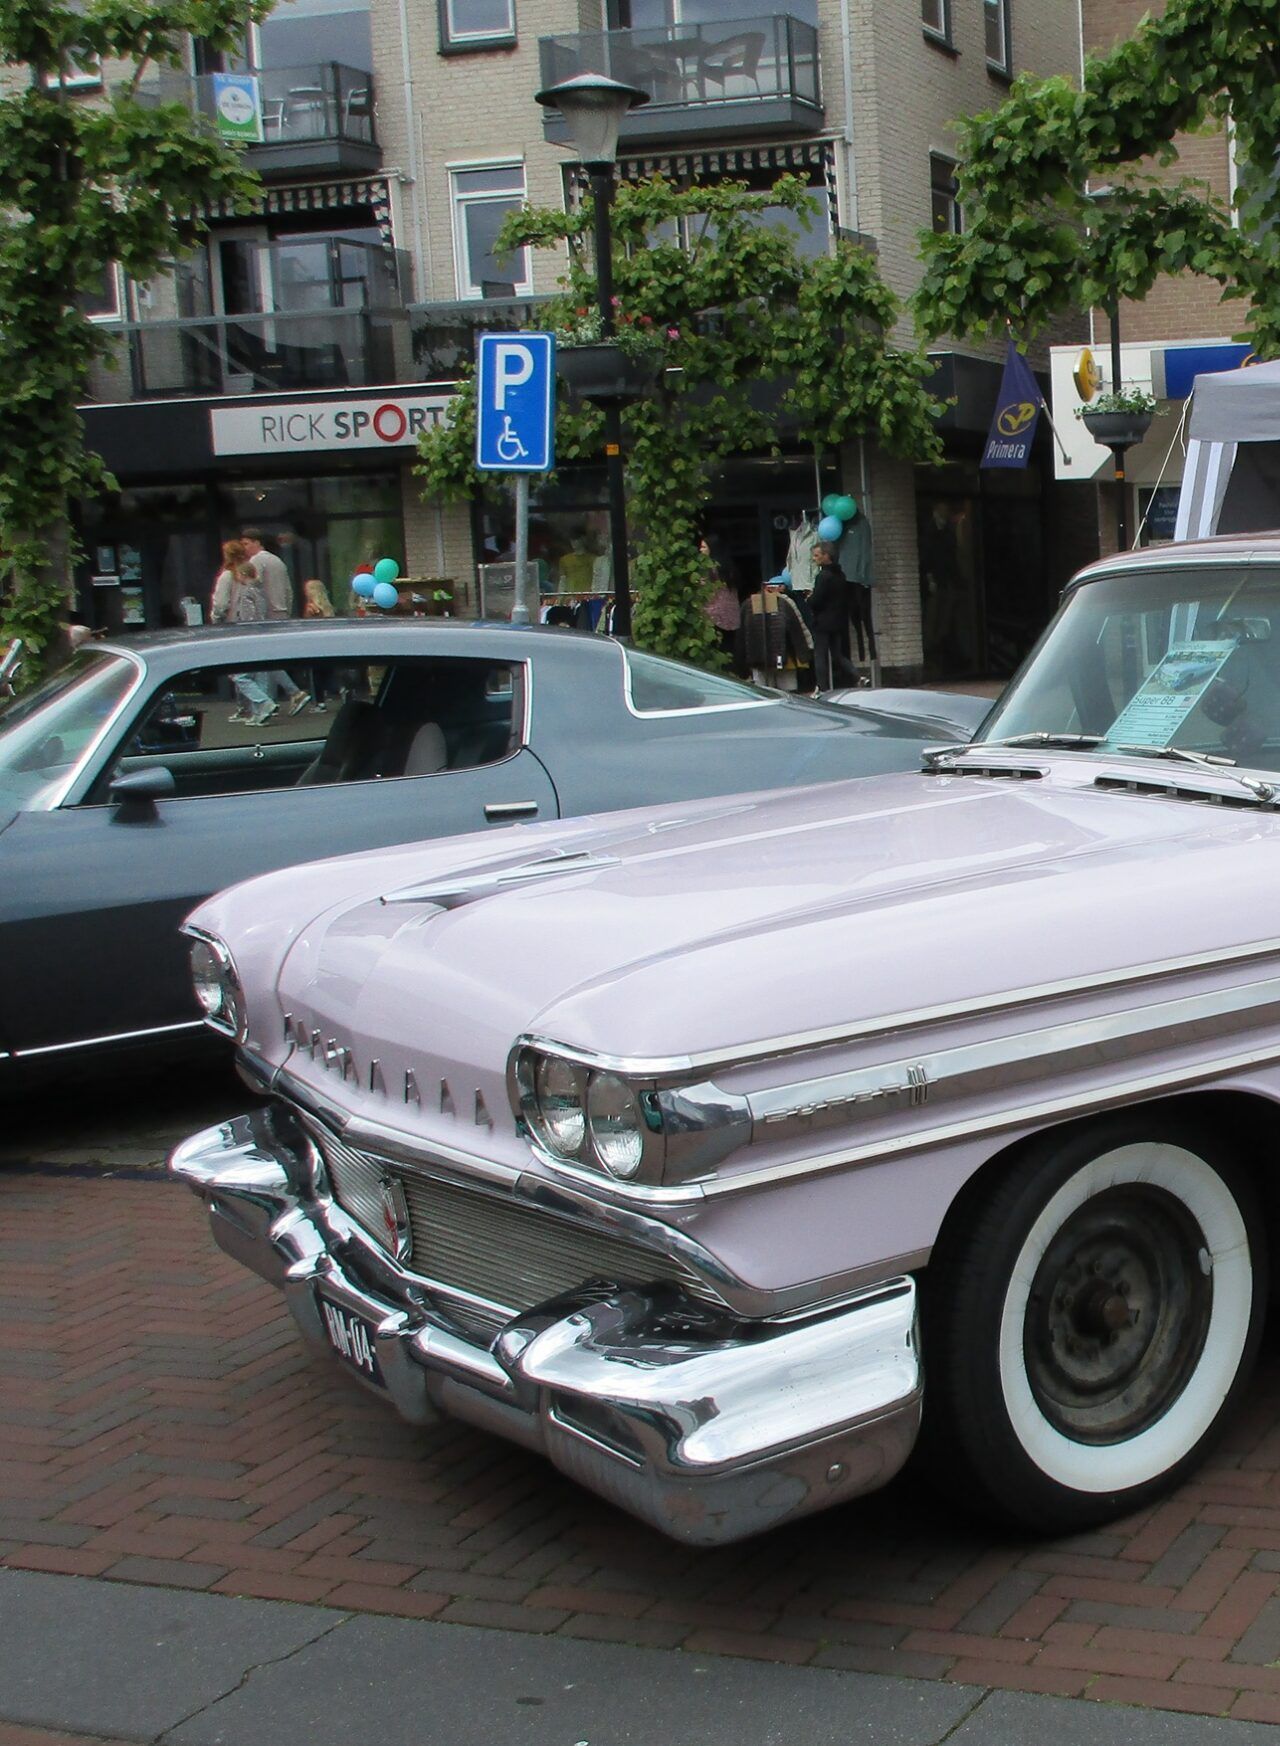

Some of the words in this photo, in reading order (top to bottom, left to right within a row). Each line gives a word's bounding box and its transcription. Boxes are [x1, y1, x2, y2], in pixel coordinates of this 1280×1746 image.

[495, 344, 534, 410] P
[261, 413, 328, 443] RICK
[986, 440, 1026, 459] Primera
